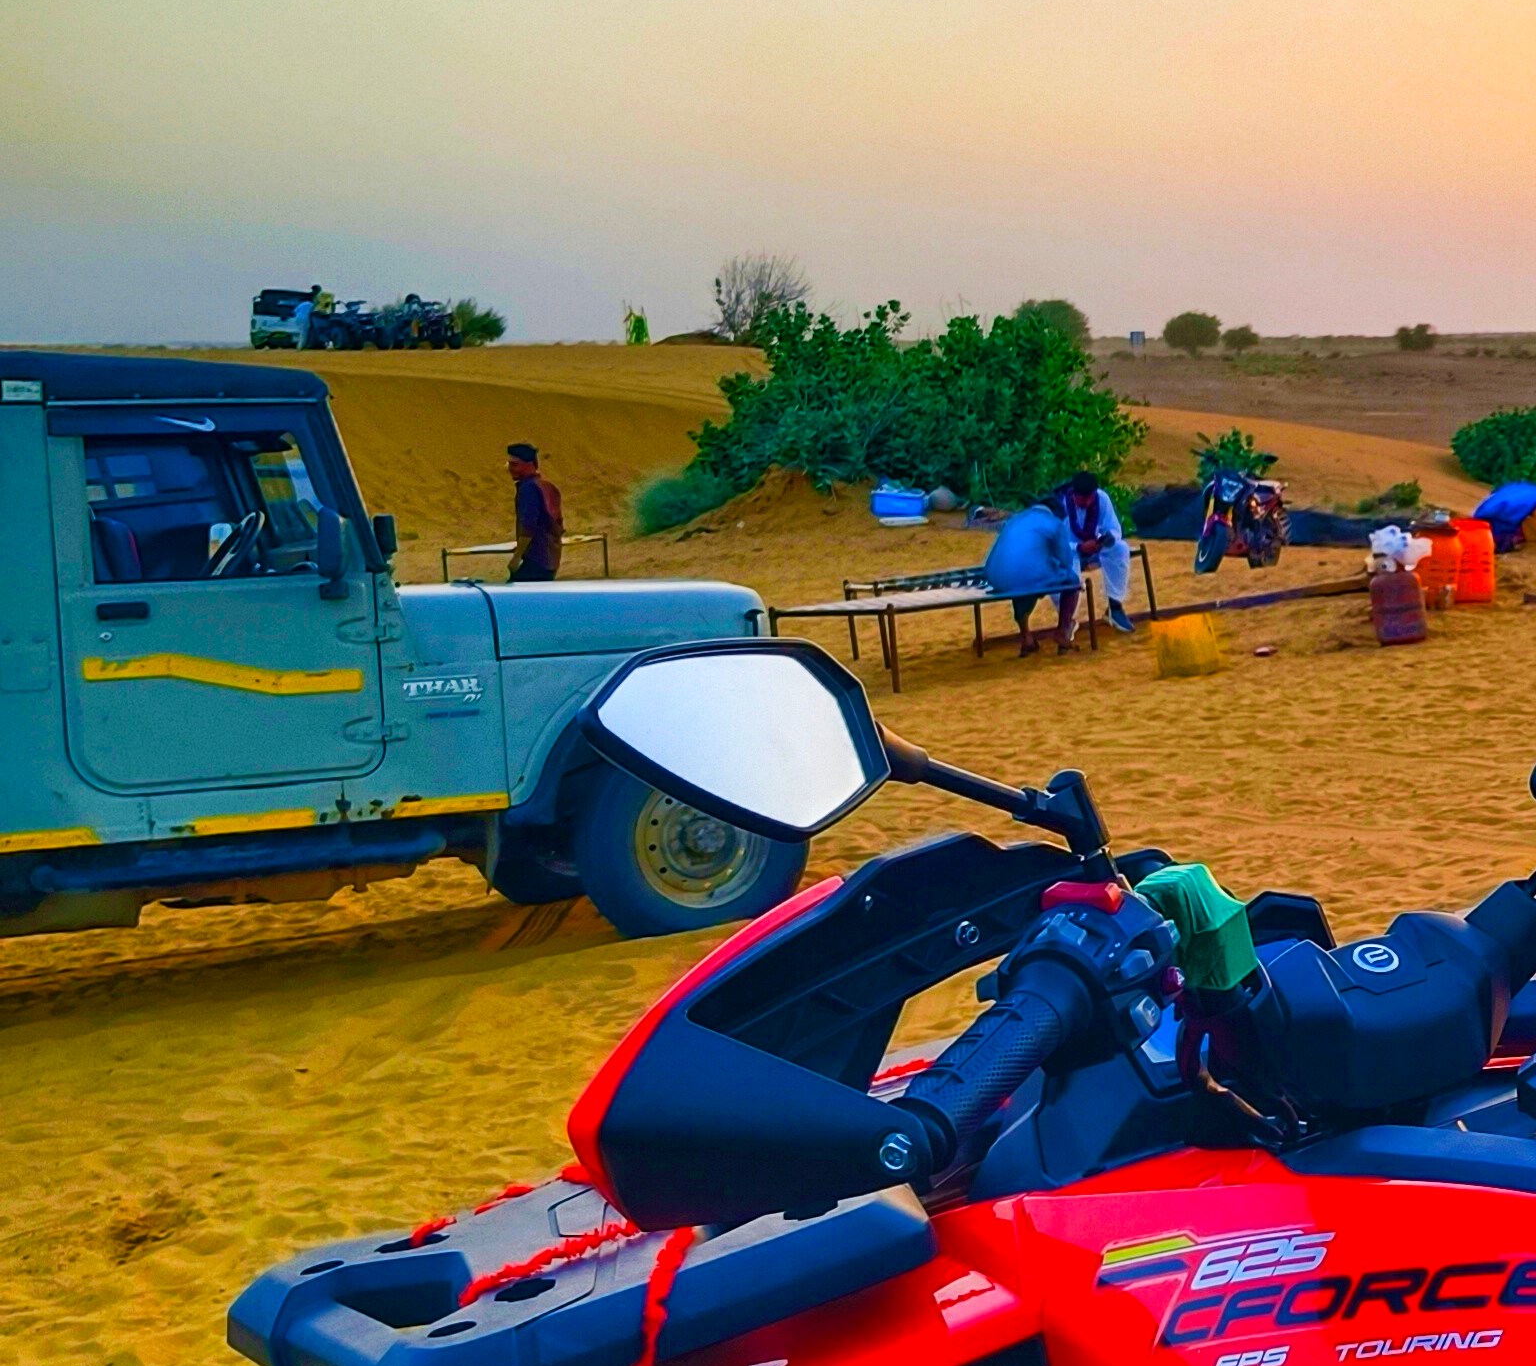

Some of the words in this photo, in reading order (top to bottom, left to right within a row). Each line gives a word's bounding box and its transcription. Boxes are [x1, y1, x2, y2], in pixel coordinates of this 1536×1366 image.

[403, 679, 483, 697] THAR
[1190, 1232, 1336, 1291] 625
[1335, 1329, 1504, 1363] TOURING
